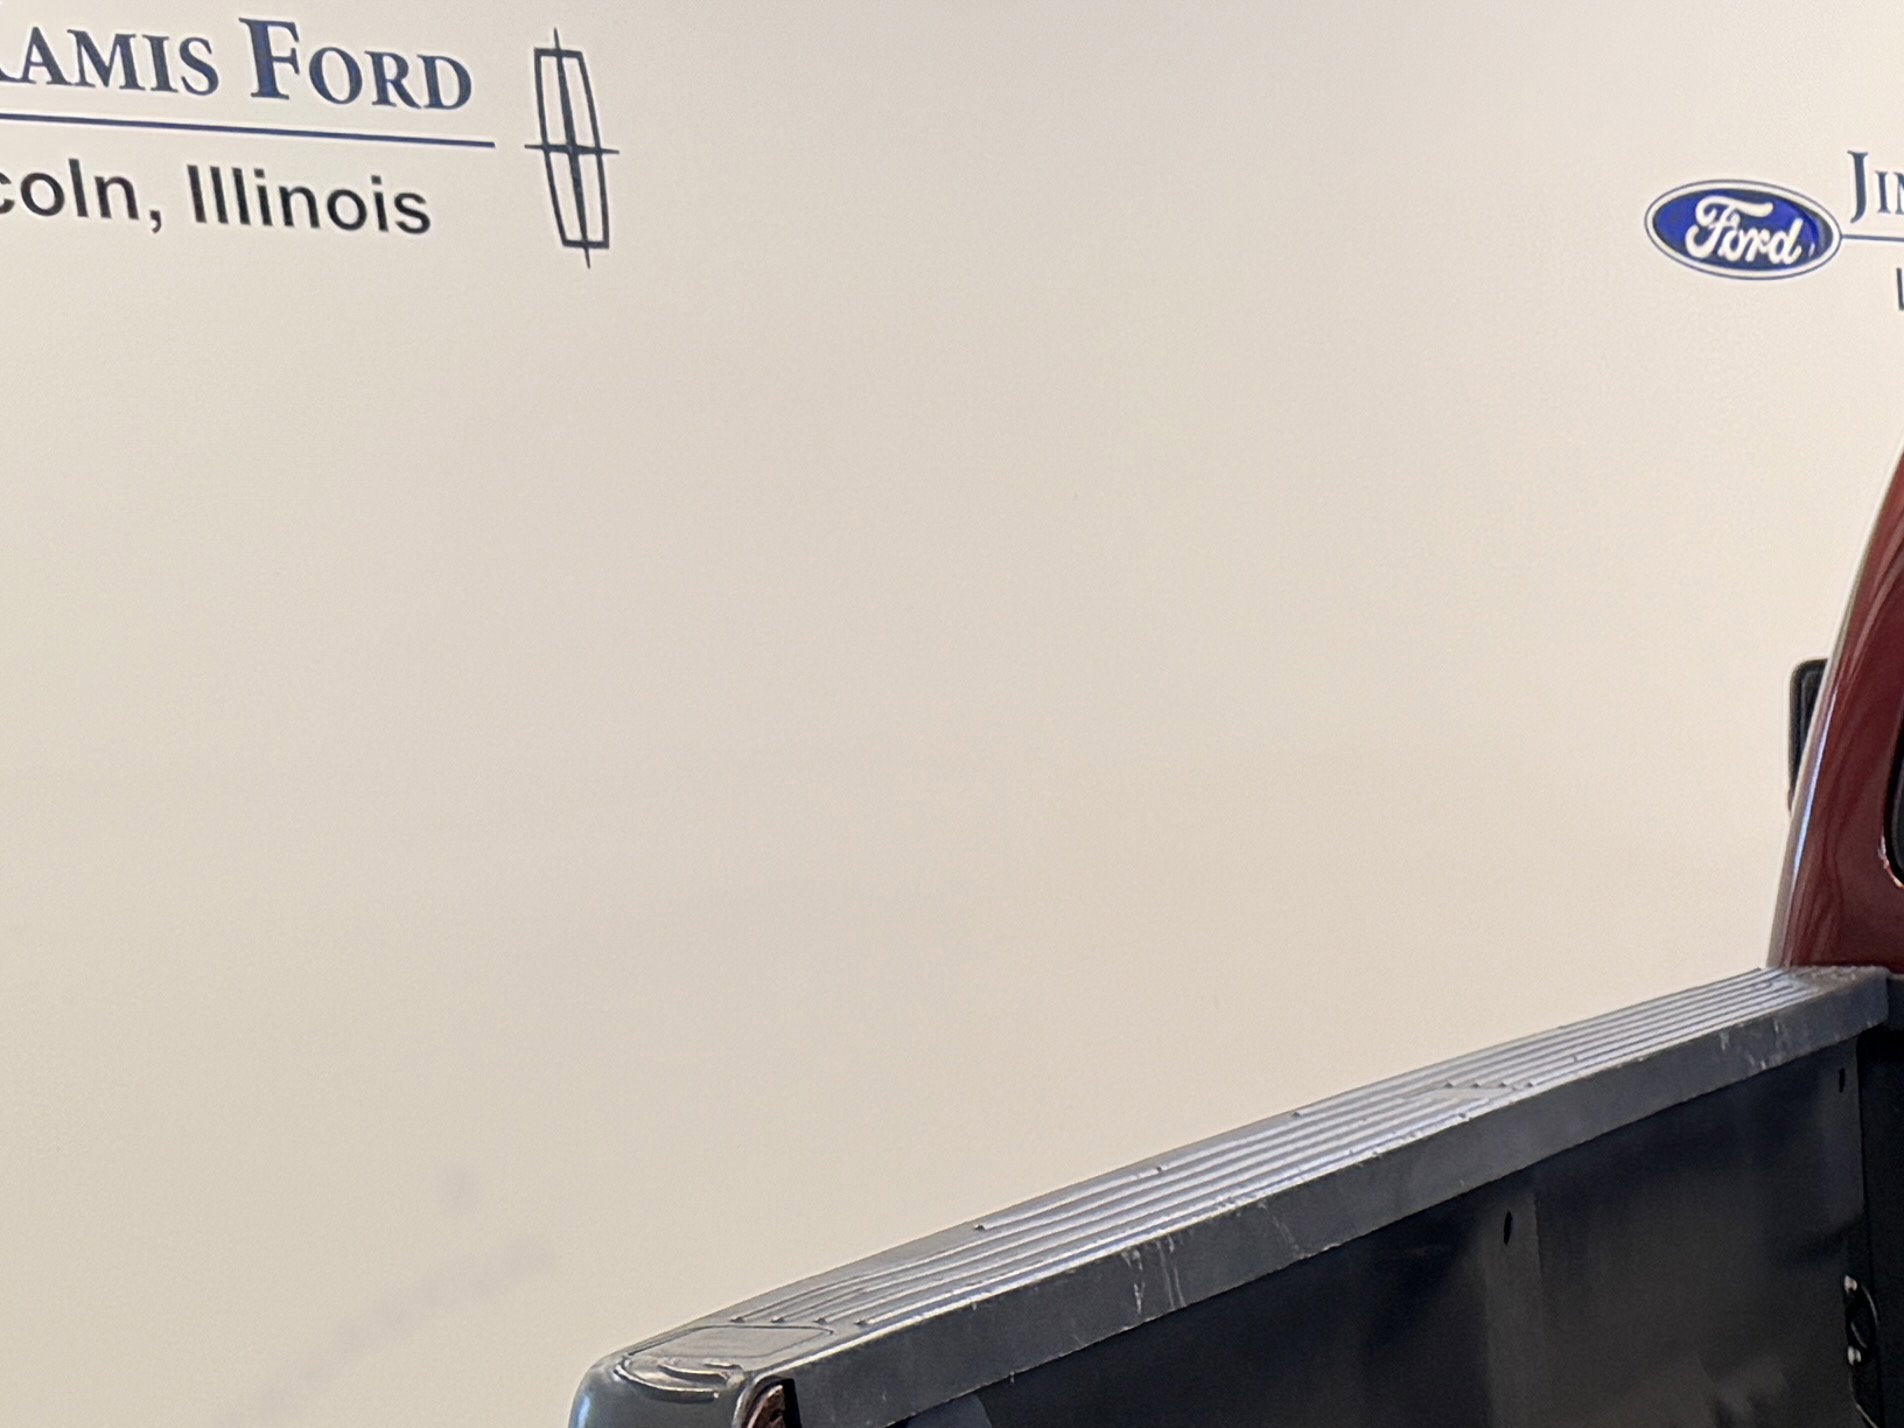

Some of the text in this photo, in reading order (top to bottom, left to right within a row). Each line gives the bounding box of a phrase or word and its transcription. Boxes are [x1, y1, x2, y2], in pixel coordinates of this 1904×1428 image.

[0, 18, 471, 110] AMIS FORD
[187, 165, 431, 235] Illinois
[1685, 195, 1803, 265] Ford
